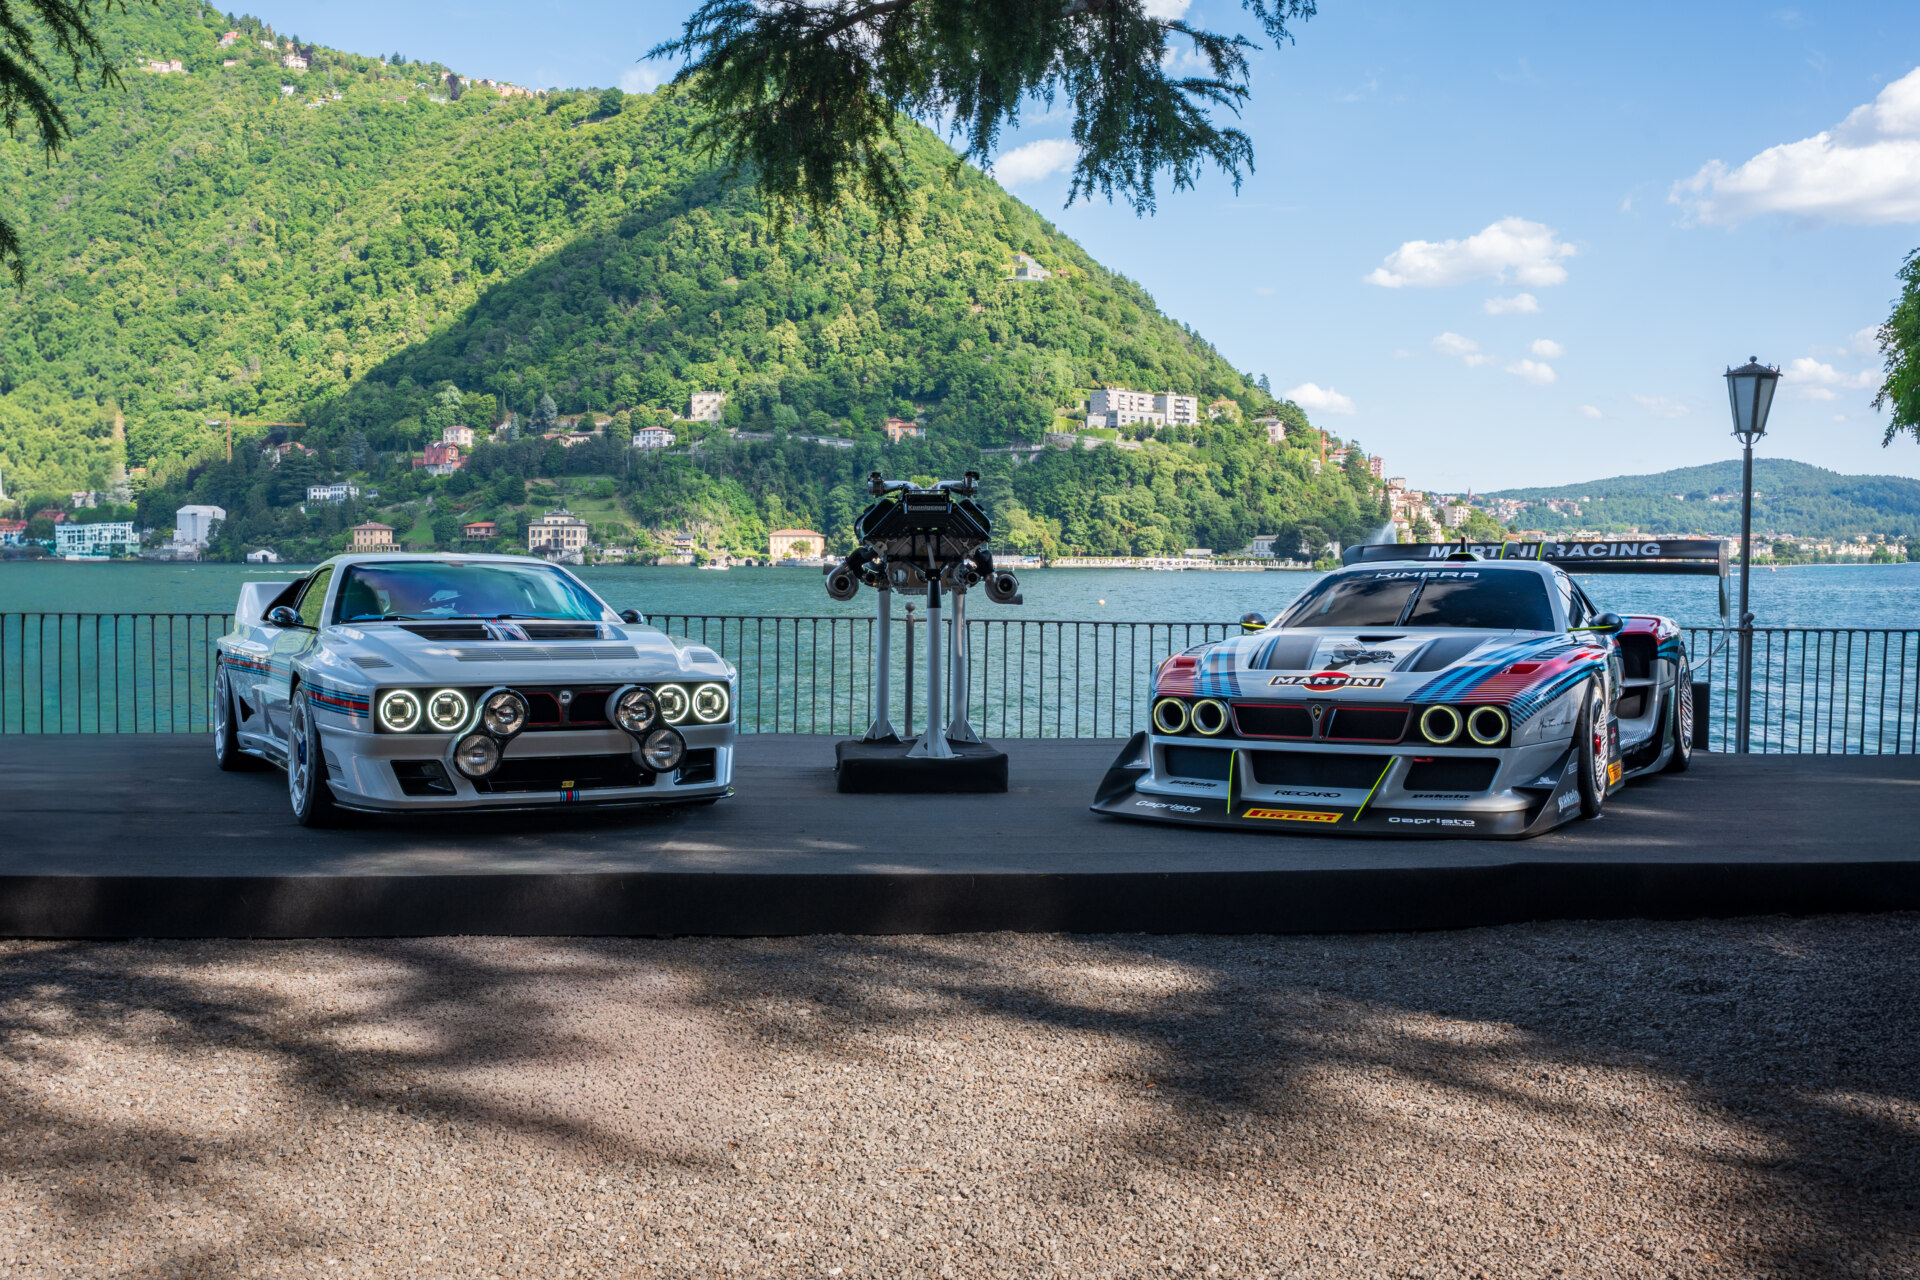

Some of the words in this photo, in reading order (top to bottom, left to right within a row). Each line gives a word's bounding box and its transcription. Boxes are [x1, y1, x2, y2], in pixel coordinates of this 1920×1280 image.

[1428, 545, 1537, 558] MRTI
[1556, 542, 1661, 558] RACING
[1375, 571, 1480, 579] KIMERA
[1274, 676, 1382, 687] MARTINI
[1274, 789, 1342, 798] RECARO
[1248, 808, 1338, 822] PIRELLI
